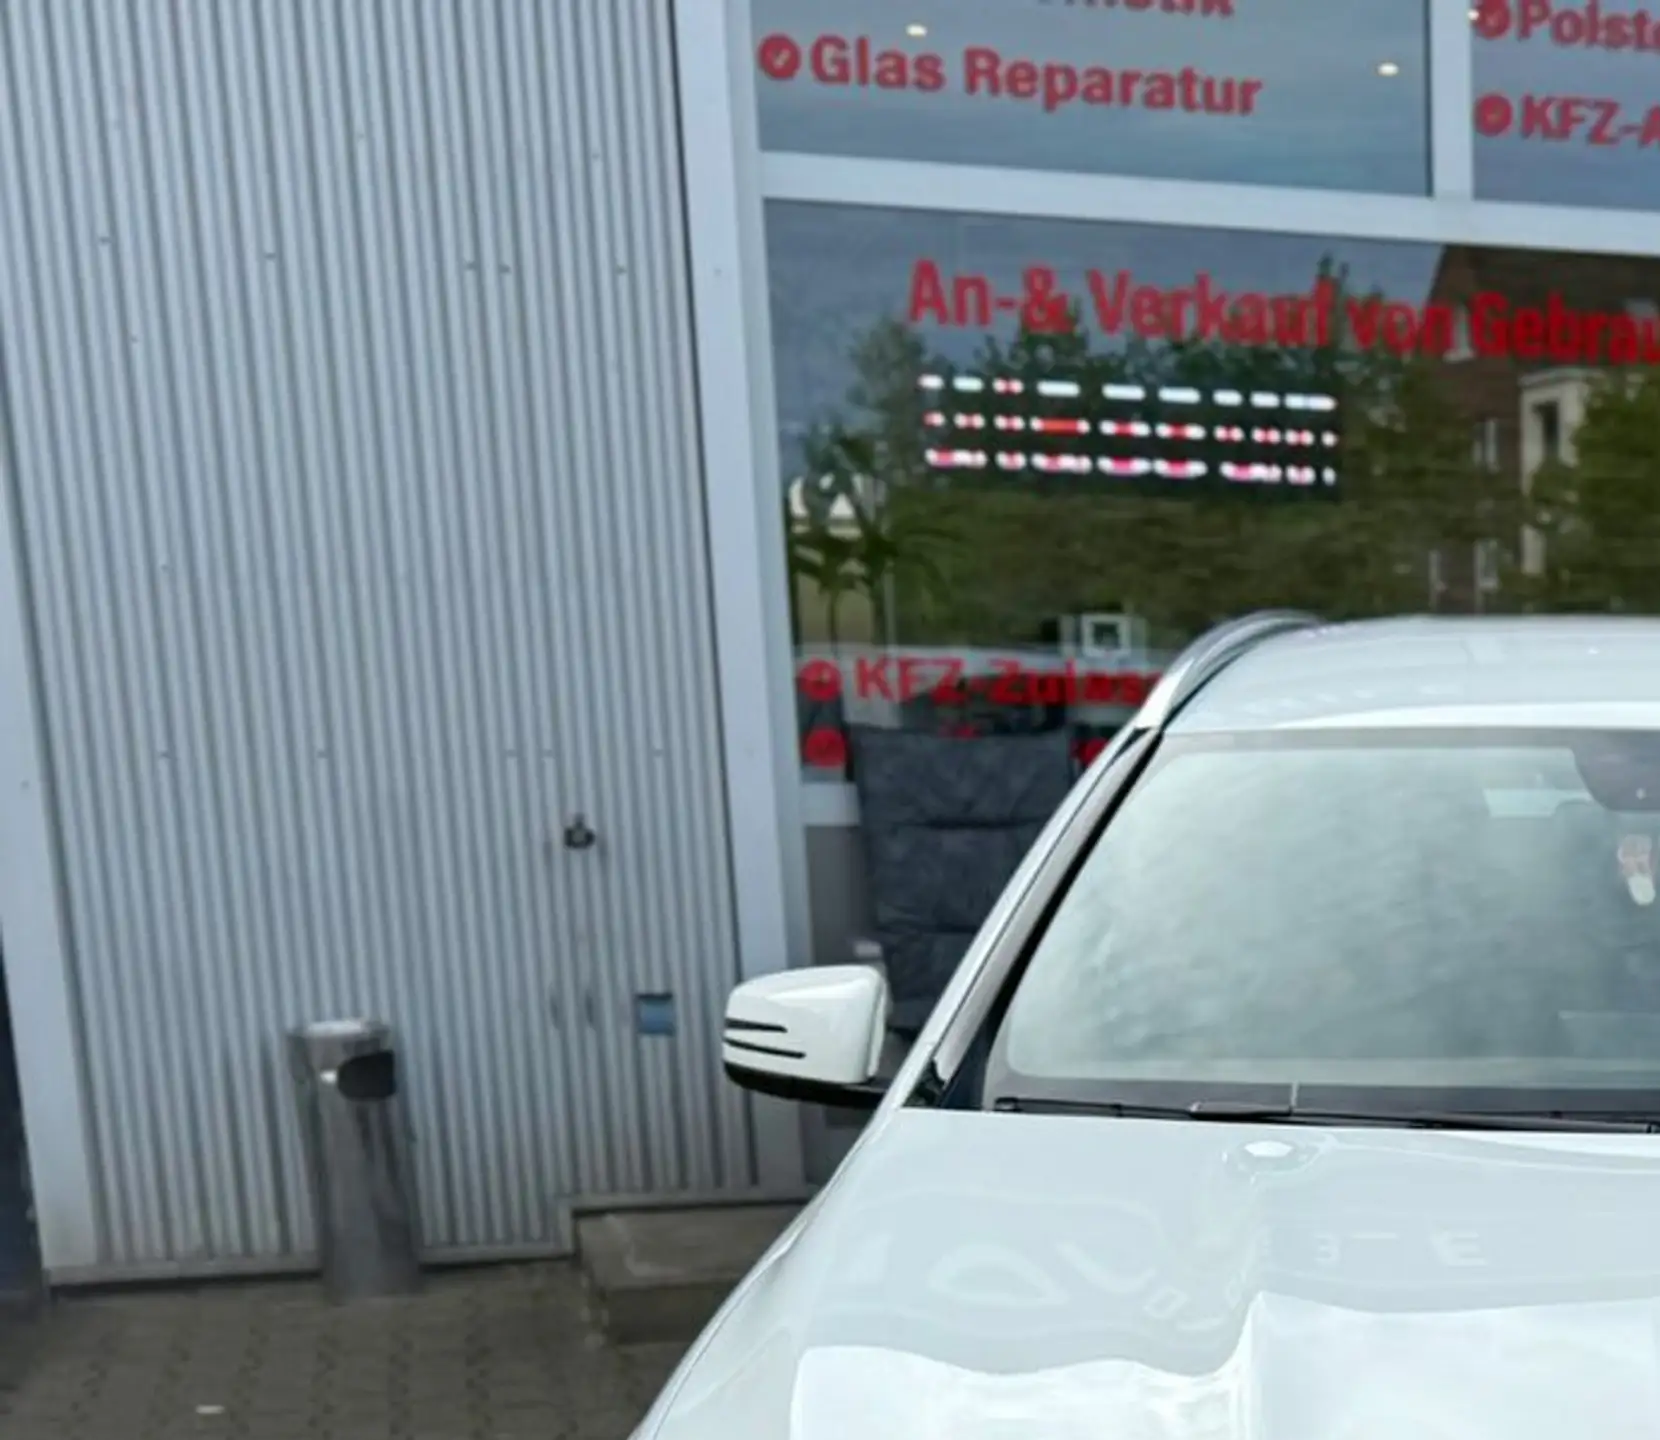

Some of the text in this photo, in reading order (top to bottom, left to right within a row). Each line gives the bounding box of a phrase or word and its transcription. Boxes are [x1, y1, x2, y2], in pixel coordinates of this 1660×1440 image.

[811, 35, 1262, 117] Glas Reparatur
[1087, 268, 1334, 350] Verkauf
[1346, 294, 1454, 355] von
